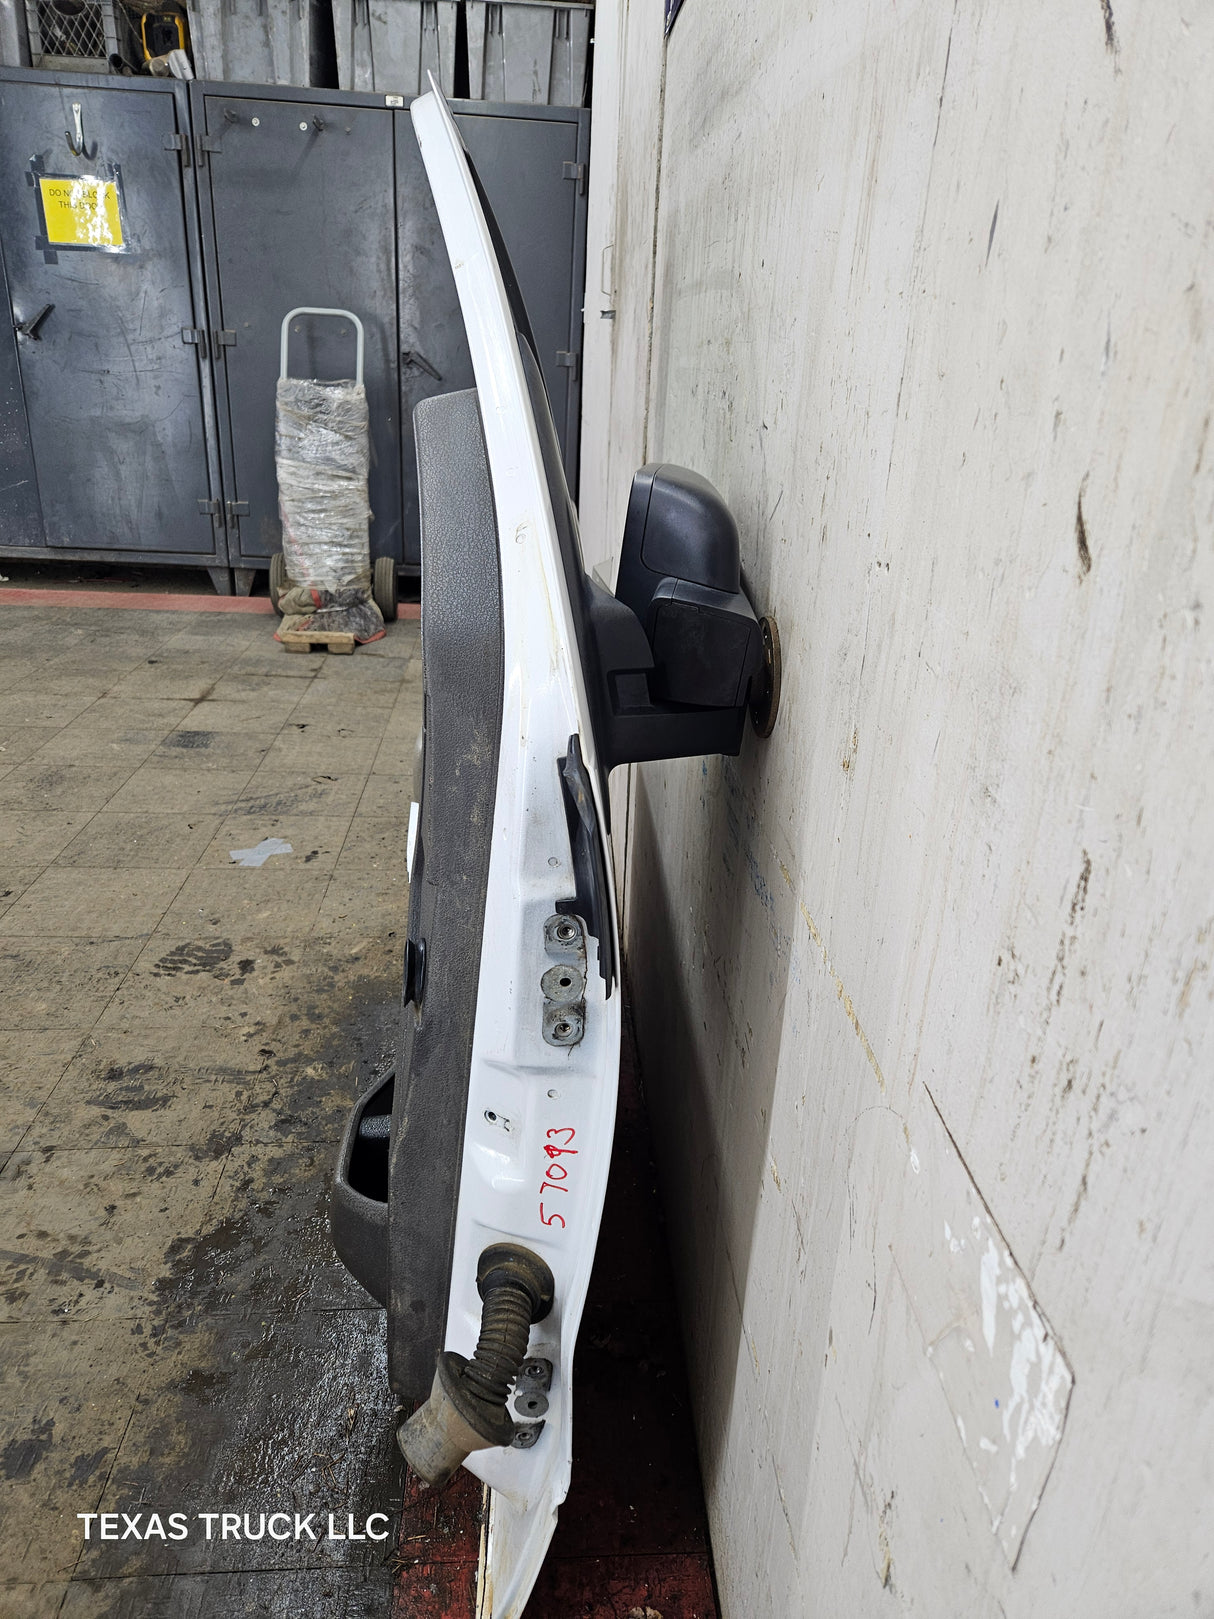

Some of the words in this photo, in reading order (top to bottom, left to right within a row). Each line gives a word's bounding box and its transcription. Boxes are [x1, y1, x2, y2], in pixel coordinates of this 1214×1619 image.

[49, 188, 62, 197] DO
[82, 190, 111, 200] BLOK
[79, 201, 98, 210] DOO
[540, 1127, 578, 1229] 57093
